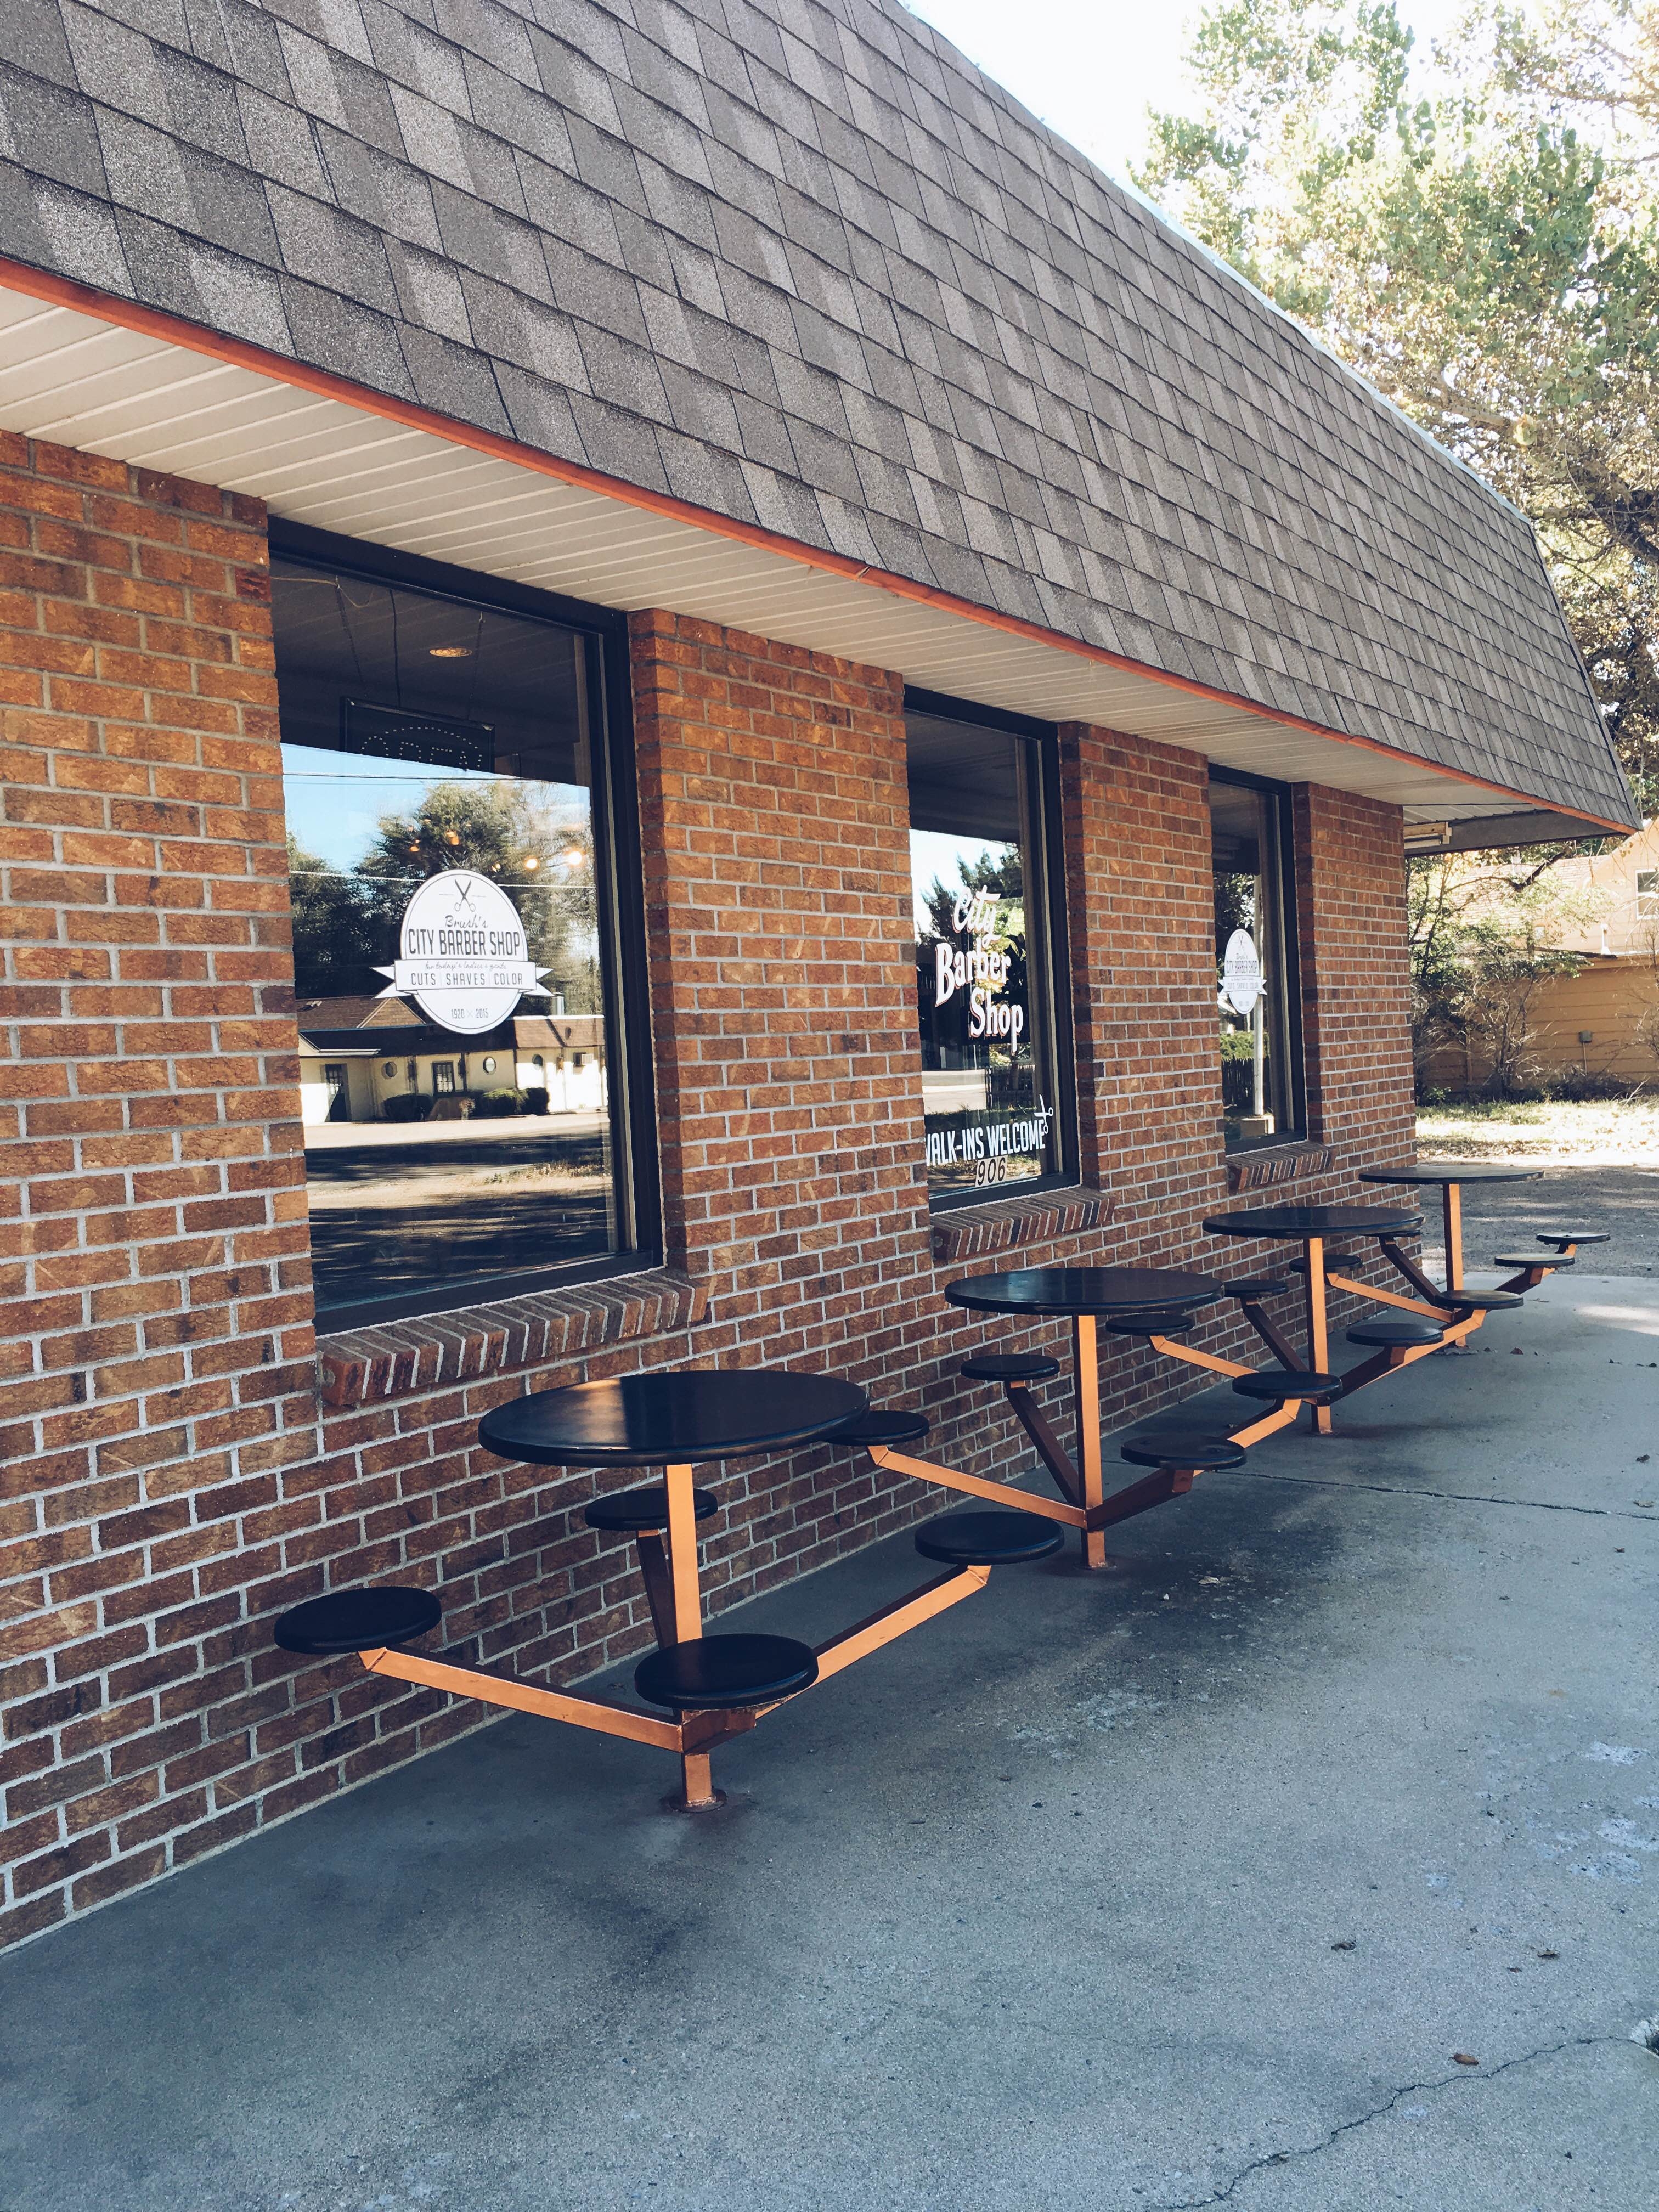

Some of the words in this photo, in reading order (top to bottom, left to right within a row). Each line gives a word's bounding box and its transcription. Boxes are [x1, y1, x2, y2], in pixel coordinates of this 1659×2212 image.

[444, 915, 489, 928] Brush's
[952, 884, 1001, 949] City
[408, 929, 435, 955] CITY
[439, 930, 487, 956] BARBER
[490, 931, 521, 956] SHOP
[411, 973, 436, 985] CUTS
[446, 973, 486, 985] SHAVES
[494, 973, 523, 985] COLOR
[934, 936, 1011, 1008] Barber
[451, 1009, 465, 1019] 1920
[476, 1008, 489, 1018] 2015
[969, 987, 1023, 1053] Shop
[986, 1119, 1046, 1156] WELCOME
[977, 1157, 1006, 1186] 906
